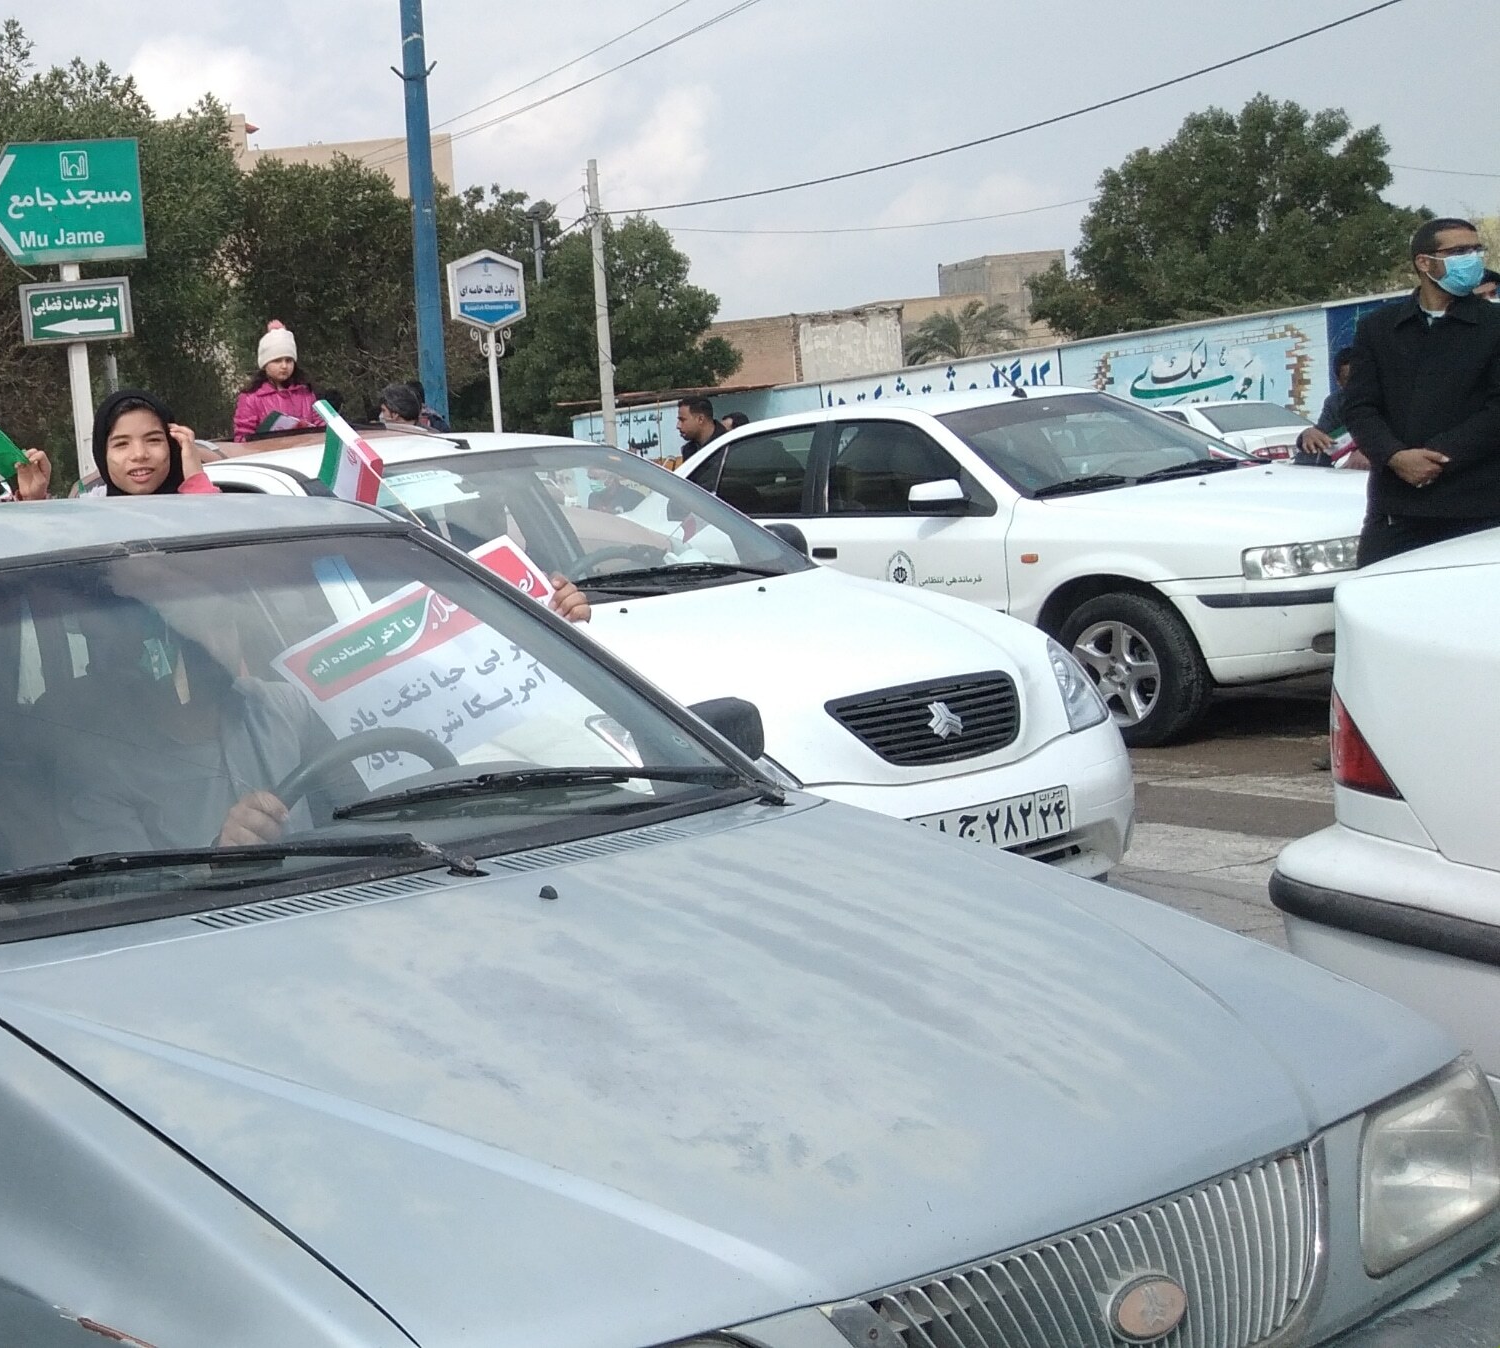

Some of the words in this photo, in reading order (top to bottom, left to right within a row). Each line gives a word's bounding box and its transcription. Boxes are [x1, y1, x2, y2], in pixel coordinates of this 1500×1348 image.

[8, 187, 59, 219] جامع
[60, 187, 132, 209] مسجد
[20, 230, 49, 248] Mu
[55, 228, 105, 246] Jame
[32, 296, 63, 316] قضایی
[64, 294, 98, 310] خدمات
[97, 292, 119, 312] دفتر
[918, 576, 945, 588] انتظامی
[945, 574, 983, 587] فرماندهی
[380, 621, 400, 645] آخر
[400, 615, 417, 629] تا
[331, 635, 376, 665] ایستاده
[311, 656, 331, 678] ایم
[475, 648, 505, 675] بی
[429, 666, 466, 691] حیا
[462, 659, 547, 720] آمریکا
[381, 677, 432, 718] ننگت
[349, 707, 382, 734] باد
[1038, 788, 1064, 801] ایران
[1038, 800, 1067, 834] ۲۴
